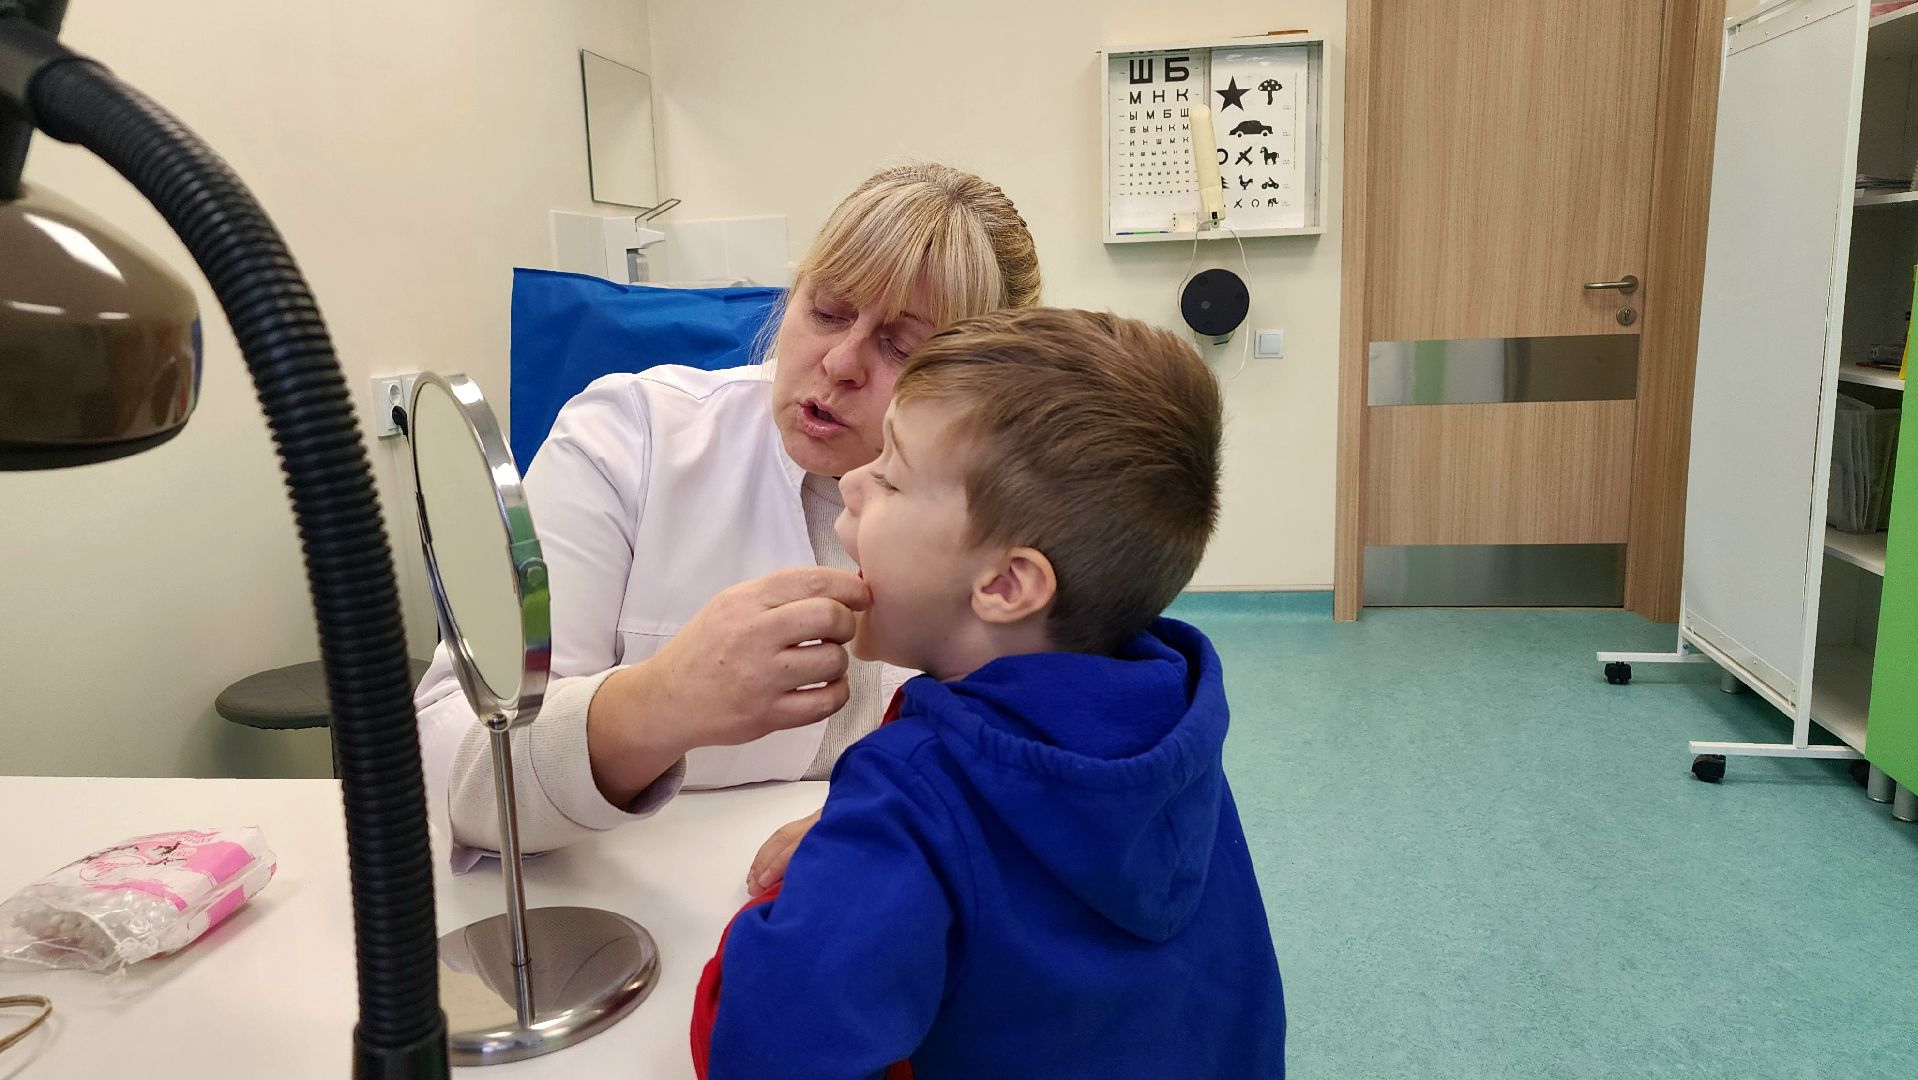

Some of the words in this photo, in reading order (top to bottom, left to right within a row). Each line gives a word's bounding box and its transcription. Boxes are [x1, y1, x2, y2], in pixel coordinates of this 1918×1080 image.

[1129, 59, 1153, 84] Ш
[1165, 57, 1189, 82] Б
[1129, 91, 1142, 104] М
[1152, 89, 1165, 103] Н
[1176, 88, 1189, 101] К
[1146, 110, 1155, 120] М
[1163, 109, 1172, 118] Б
[1180, 108, 1189, 117] Ш
[1155, 124, 1163, 132] Н
